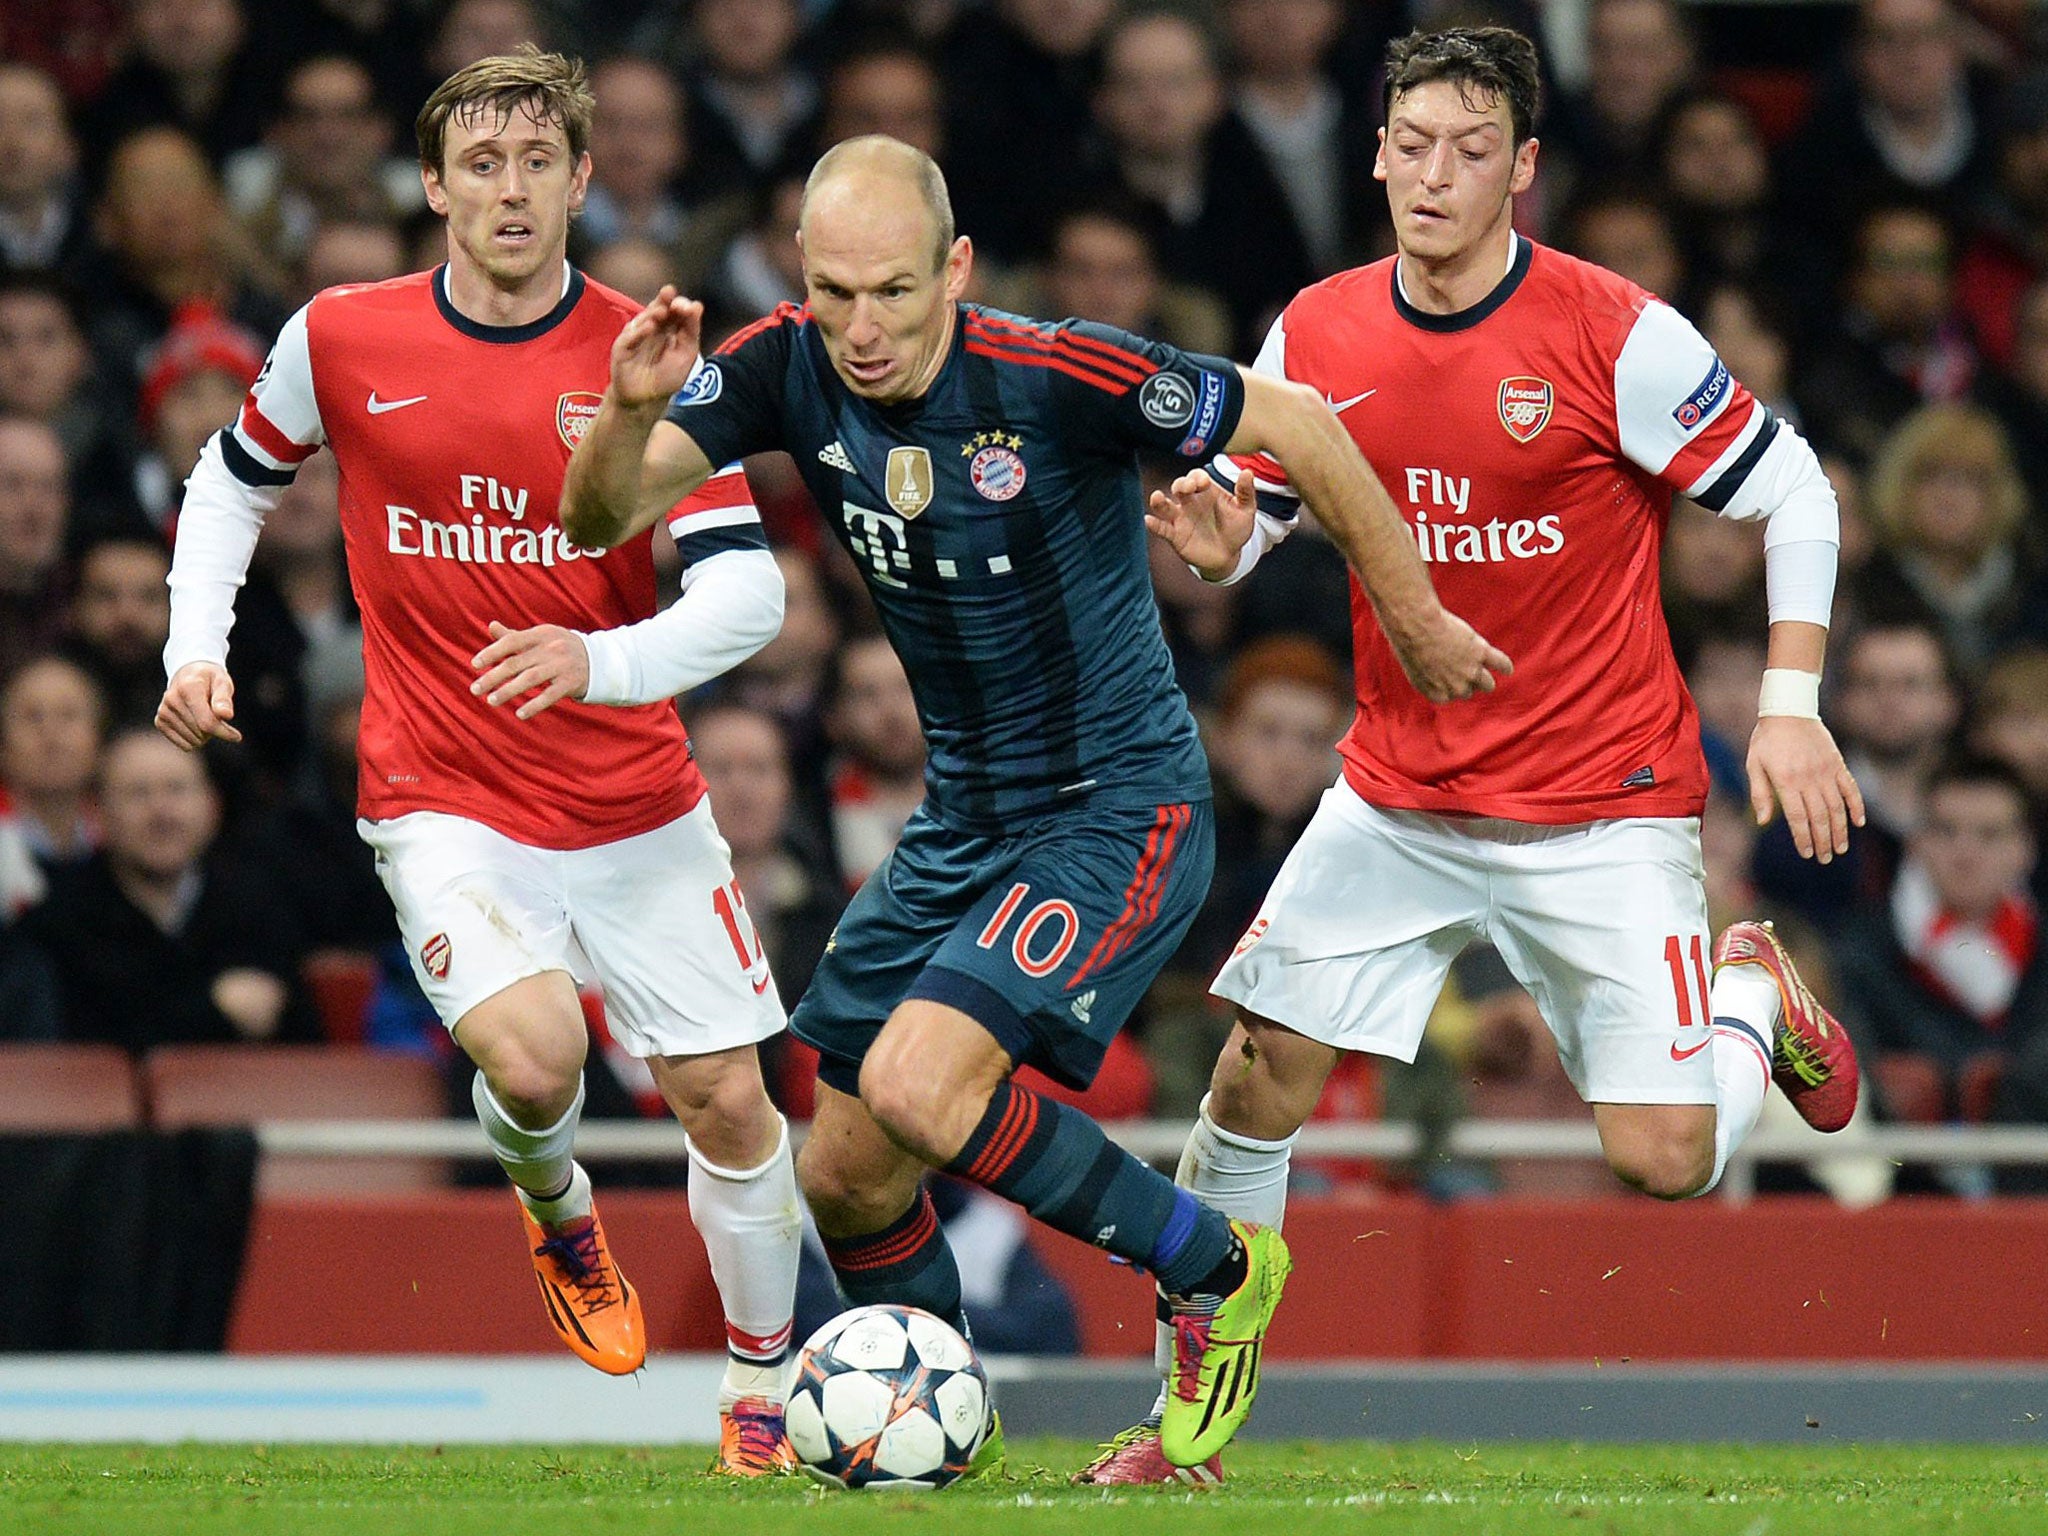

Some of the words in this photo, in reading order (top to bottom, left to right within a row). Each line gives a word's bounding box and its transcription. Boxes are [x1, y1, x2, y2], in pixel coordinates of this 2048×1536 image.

[565, 402, 600, 415] Arsena
[1196, 373, 1219, 438] RESPECT
[1506, 386, 1545, 400] Arsenal
[1696, 361, 1727, 410] RESPEC
[459, 474, 528, 521] Fly
[899, 491, 921, 501] FIFA
[1404, 467, 1471, 515] Fly
[1407, 510, 1565, 563] irates
[976, 882, 1080, 979] 10
[1664, 934, 1710, 1027] 11
